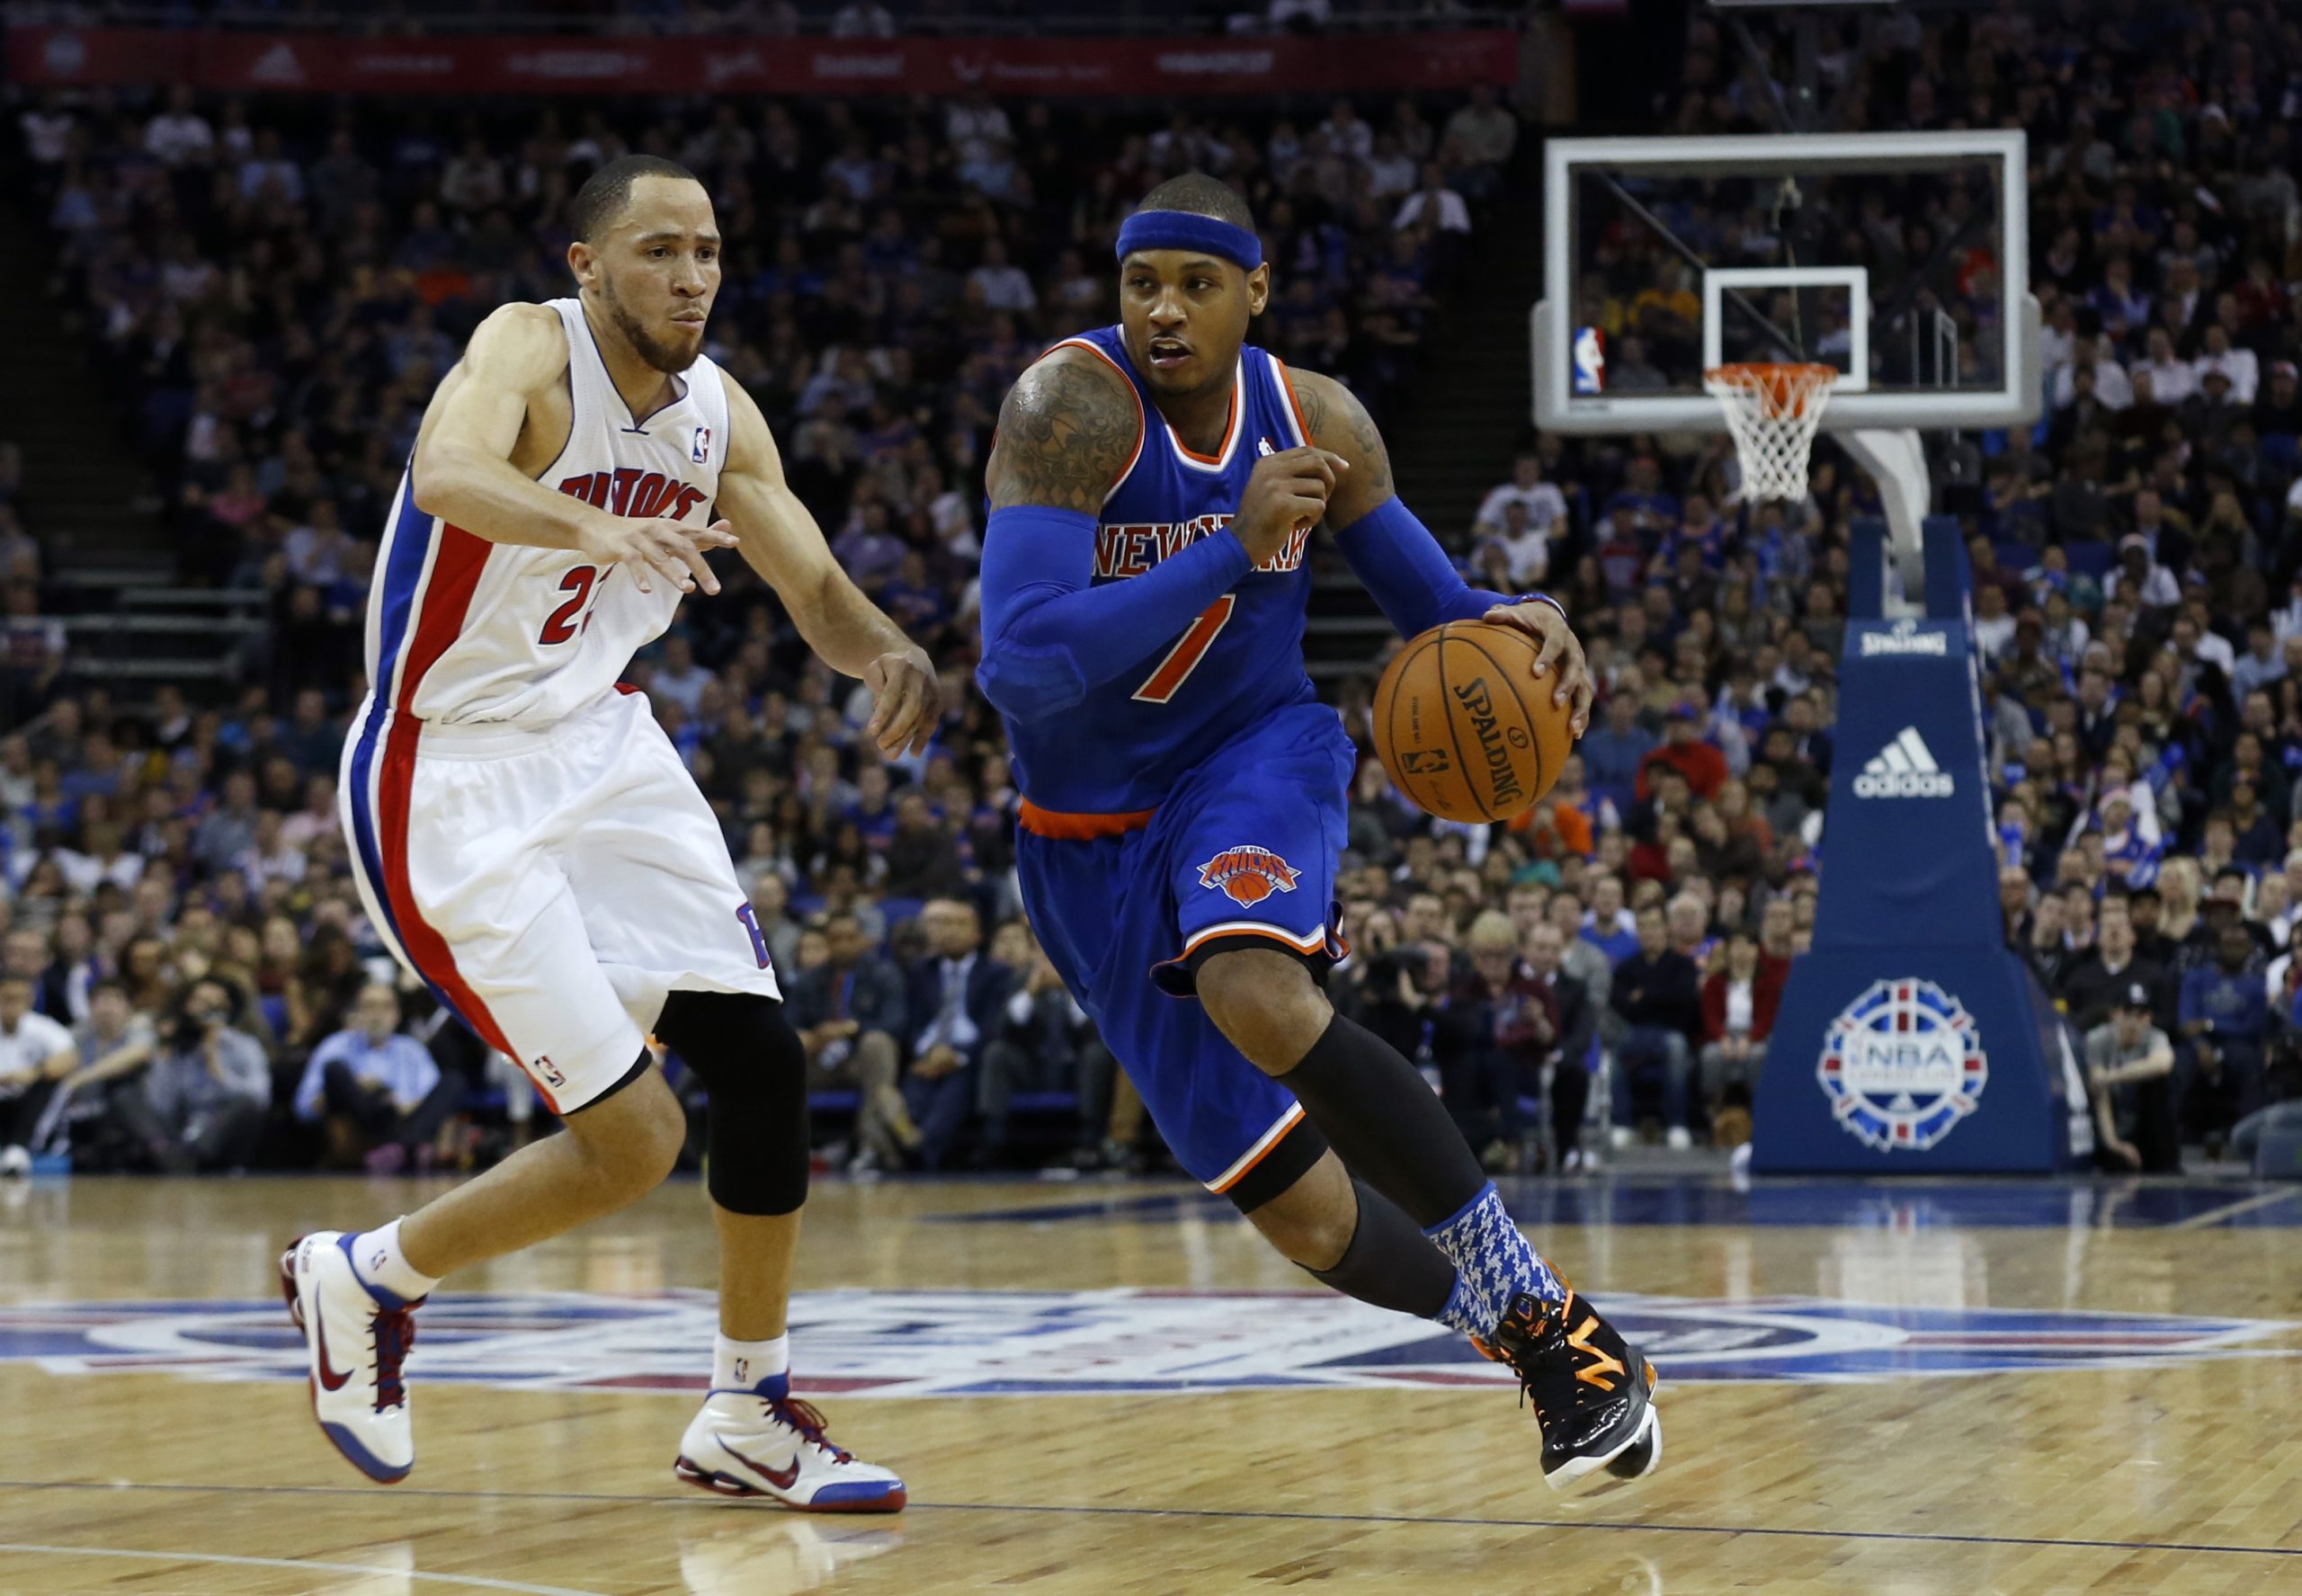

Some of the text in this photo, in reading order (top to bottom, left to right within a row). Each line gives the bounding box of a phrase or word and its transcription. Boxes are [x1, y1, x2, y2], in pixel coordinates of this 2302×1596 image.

[558, 467, 708, 522] PITONS
[538, 563, 618, 646] 2
[1453, 677, 1523, 807] SPALDING
[1852, 773, 1955, 798] adidas
[1201, 852, 1296, 889] KNICKS
[1866, 1041, 1953, 1067] NBA
